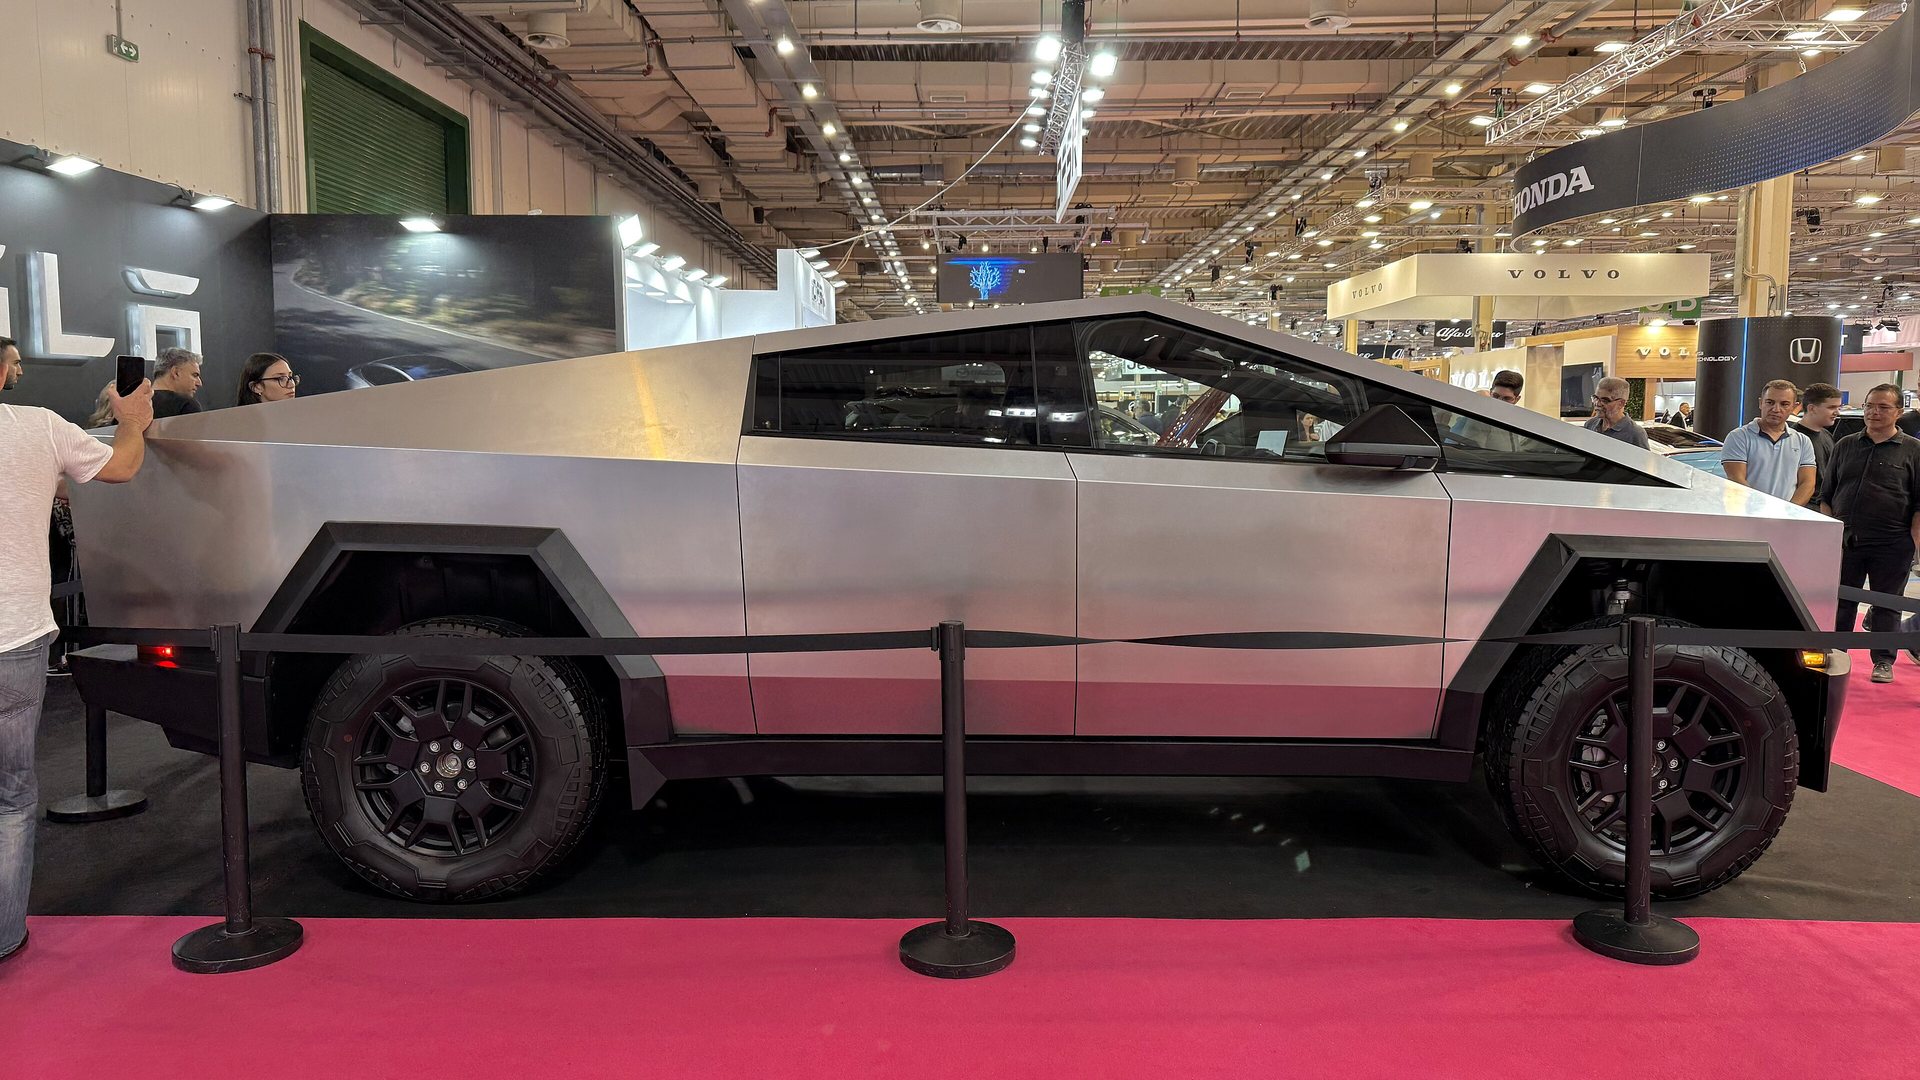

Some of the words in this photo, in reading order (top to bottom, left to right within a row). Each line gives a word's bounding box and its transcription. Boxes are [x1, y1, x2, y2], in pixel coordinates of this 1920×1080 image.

[1513, 165, 1595, 220] HONDA
[1507, 269, 1620, 279] VOLVO
[1352, 282, 1383, 299] VOLVO
[1435, 327, 1464, 342] Alfa
[1637, 347, 1690, 356] VOL
